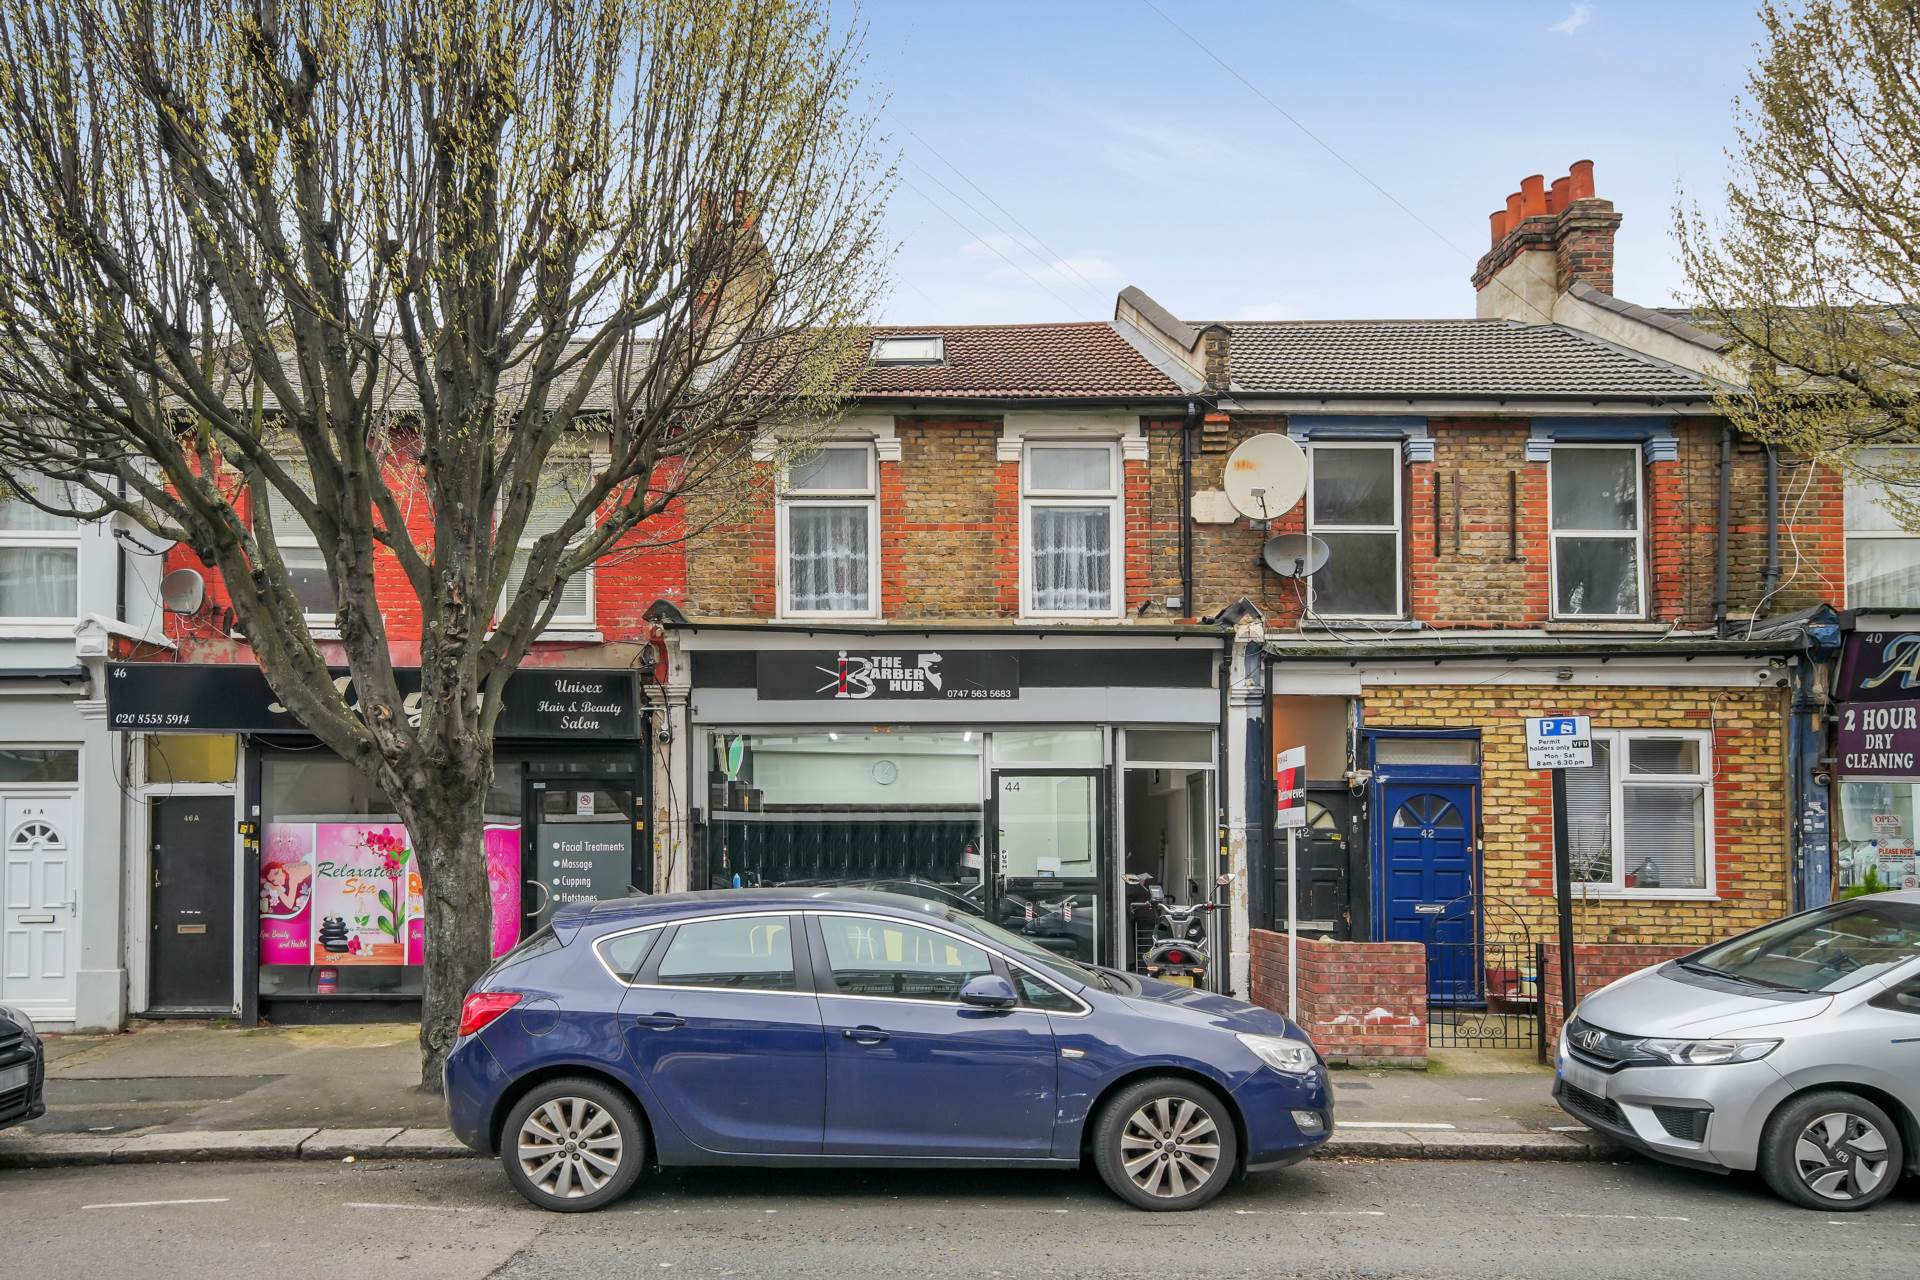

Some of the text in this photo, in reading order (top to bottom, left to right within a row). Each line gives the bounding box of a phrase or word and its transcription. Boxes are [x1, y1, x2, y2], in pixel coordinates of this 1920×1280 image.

[1865, 633, 1883, 644] 40
[871, 656, 902, 668] THE
[113, 668, 127, 679] 46
[554, 679, 604, 694] Unisex
[889, 680, 925, 692] HUB
[947, 689, 1011, 698] 0747 563 5683
[537, 701, 622, 717] Hair & Beauty
[115, 714, 190, 725] 020 8558 5914
[560, 715, 600, 730] Salon
[1844, 707, 1917, 732] 2 HOUR
[1542, 720, 1555, 735] P
[1865, 733, 1894, 750] DRY
[1845, 752, 1914, 769] CLEANING
[1004, 781, 1020, 792] 44
[1874, 815, 1899, 823] OPEN
[1295, 828, 1310, 839] 42
[1420, 829, 1435, 839] 42
[561, 841, 625, 852] Facial Treatments
[317, 861, 403, 879] Relaxation
[561, 858, 593, 871] Massage
[342, 878, 378, 898] Spa
[561, 876, 591, 888] Cupping
[561, 893, 598, 903] Hotstones
